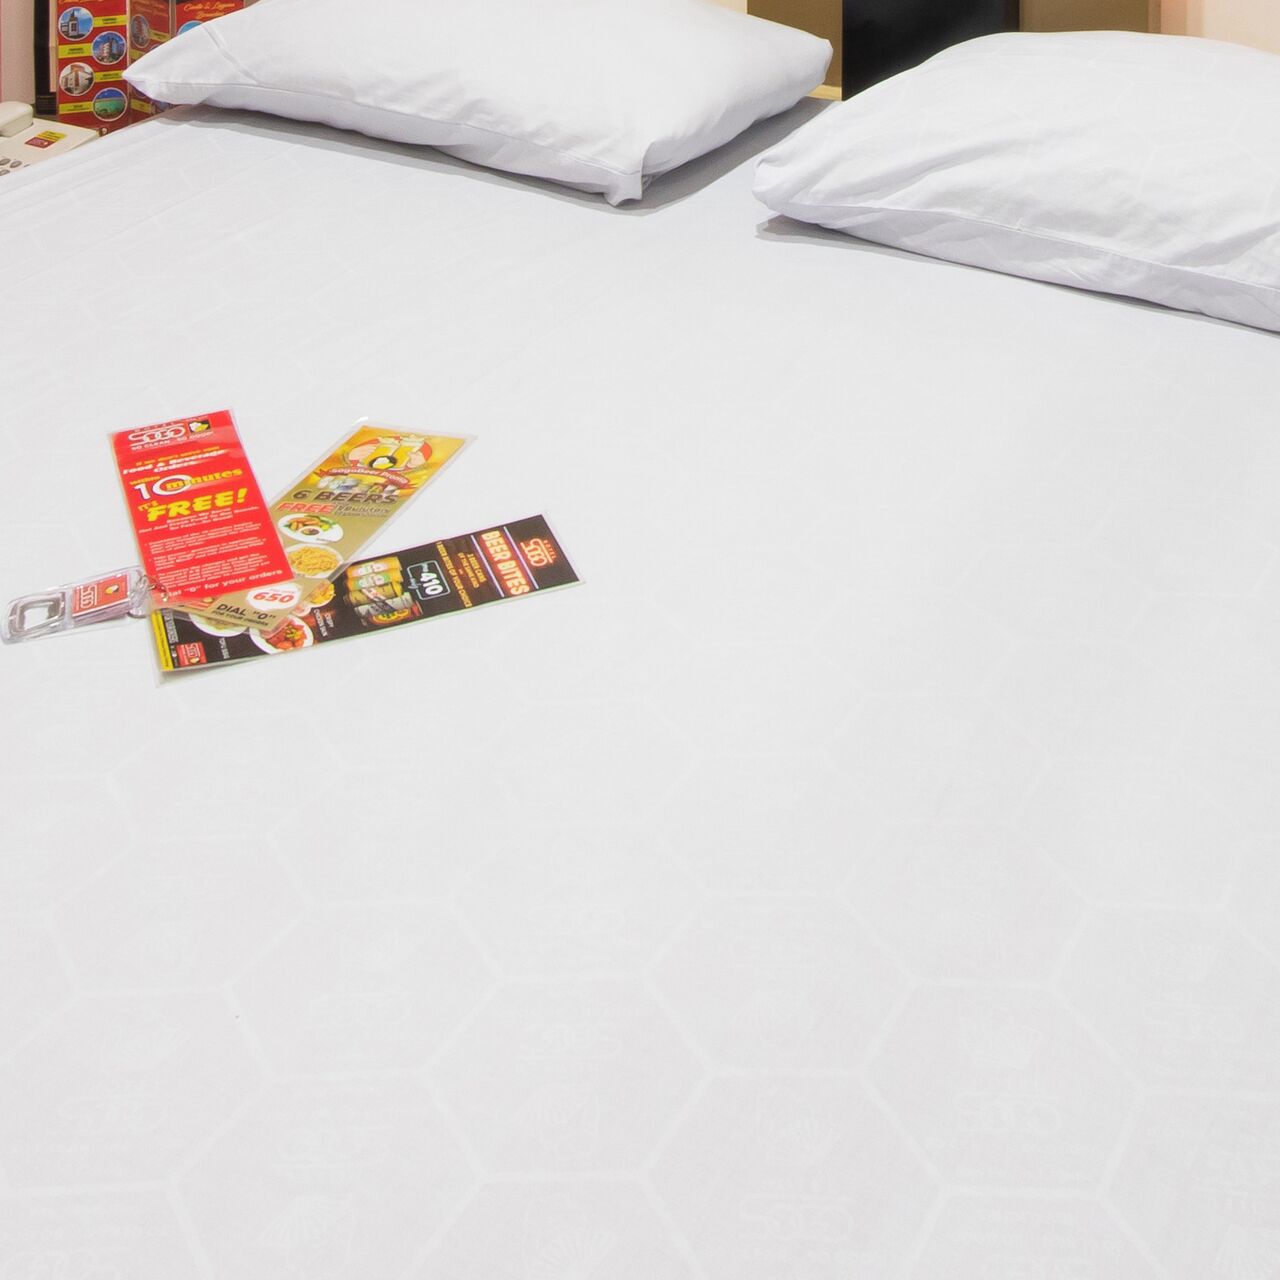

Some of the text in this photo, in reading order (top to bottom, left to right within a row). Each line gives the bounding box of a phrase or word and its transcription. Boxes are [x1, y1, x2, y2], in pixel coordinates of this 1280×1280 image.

[128, 423, 186, 448] SOGO
[123, 464, 153, 475] Food
[169, 449, 226, 465] Beverage
[134, 468, 243, 500] 10 minutes
[147, 487, 248, 522] FREE!
[278, 502, 336, 514] FREE
[292, 490, 400, 504] 6 BEERS
[481, 530, 530, 596] BEER BITES
[520, 538, 553, 567] SOGO
[205, 581, 219, 590] for
[221, 577, 246, 587] your
[249, 569, 283, 580] orders
[420, 571, 443, 595] 410
[216, 603, 247, 616] DIAL
[252, 591, 295, 604] 650
